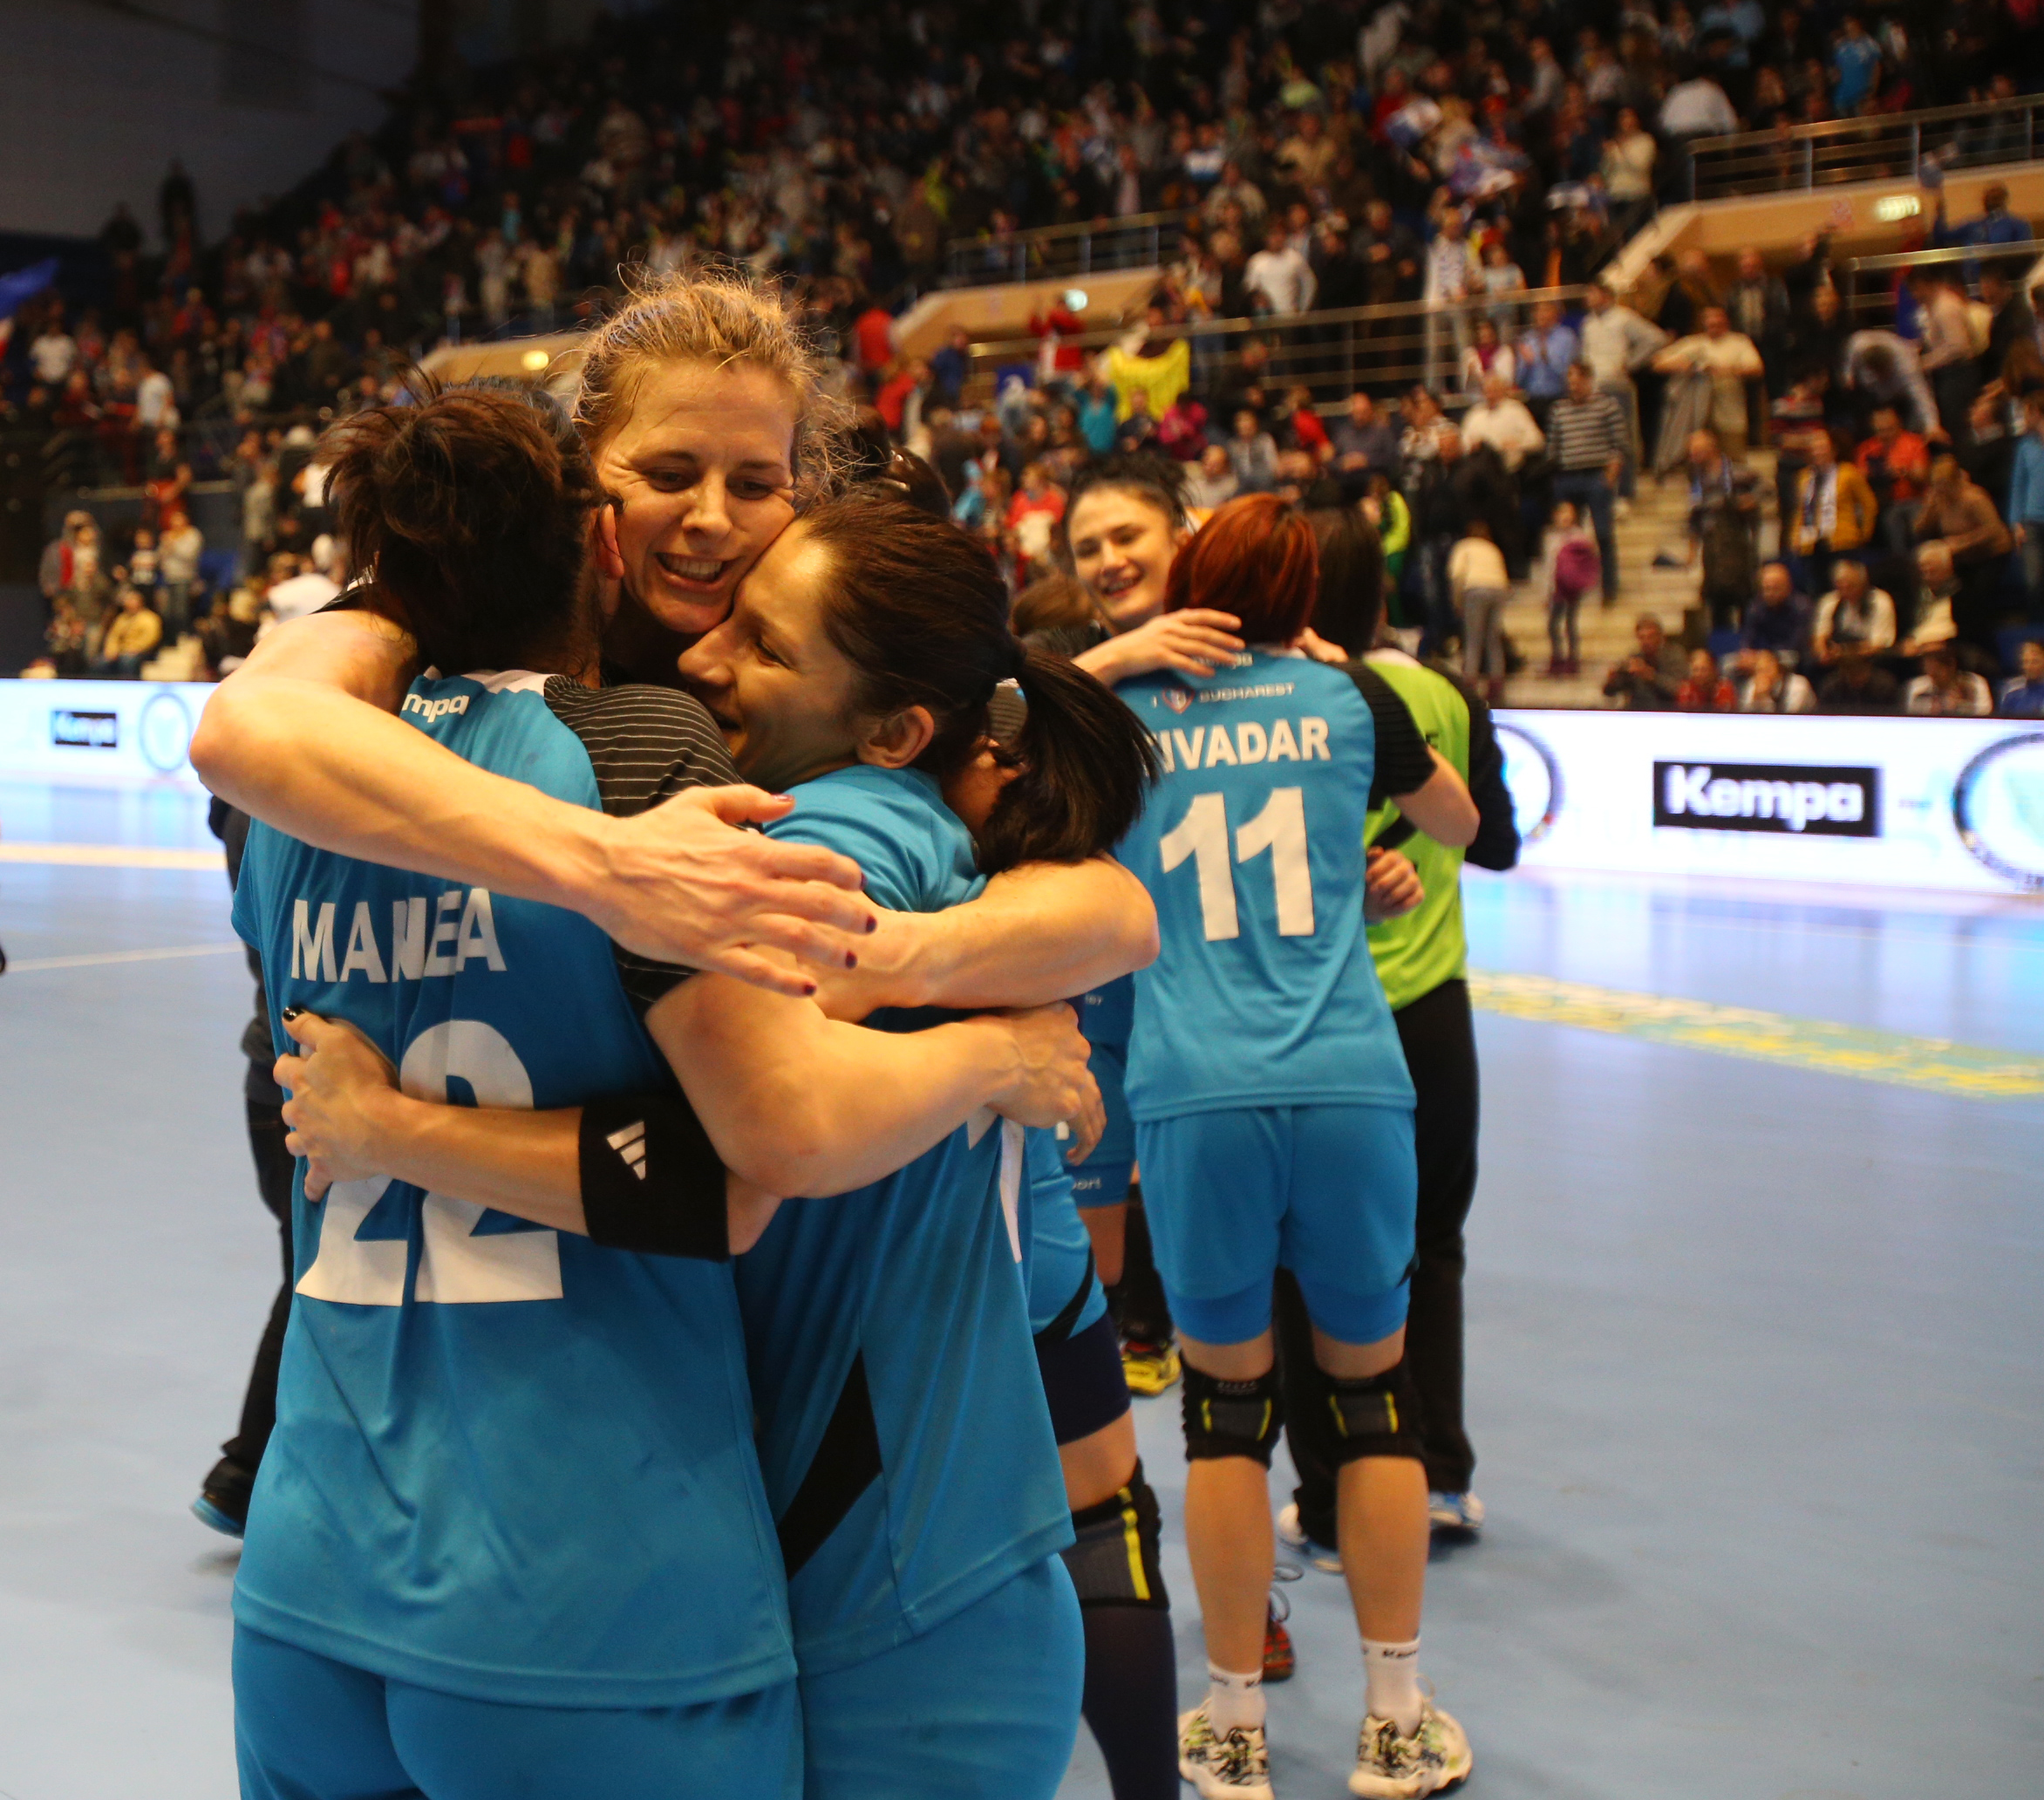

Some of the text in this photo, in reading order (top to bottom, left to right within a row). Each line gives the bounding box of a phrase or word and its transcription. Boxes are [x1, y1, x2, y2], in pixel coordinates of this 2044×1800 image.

[1199, 682, 1295, 703] BUCHAREST
[1664, 765, 1863, 832] Kempa
[1160, 787, 1315, 942] 11
[291, 888, 508, 984] MANEA
